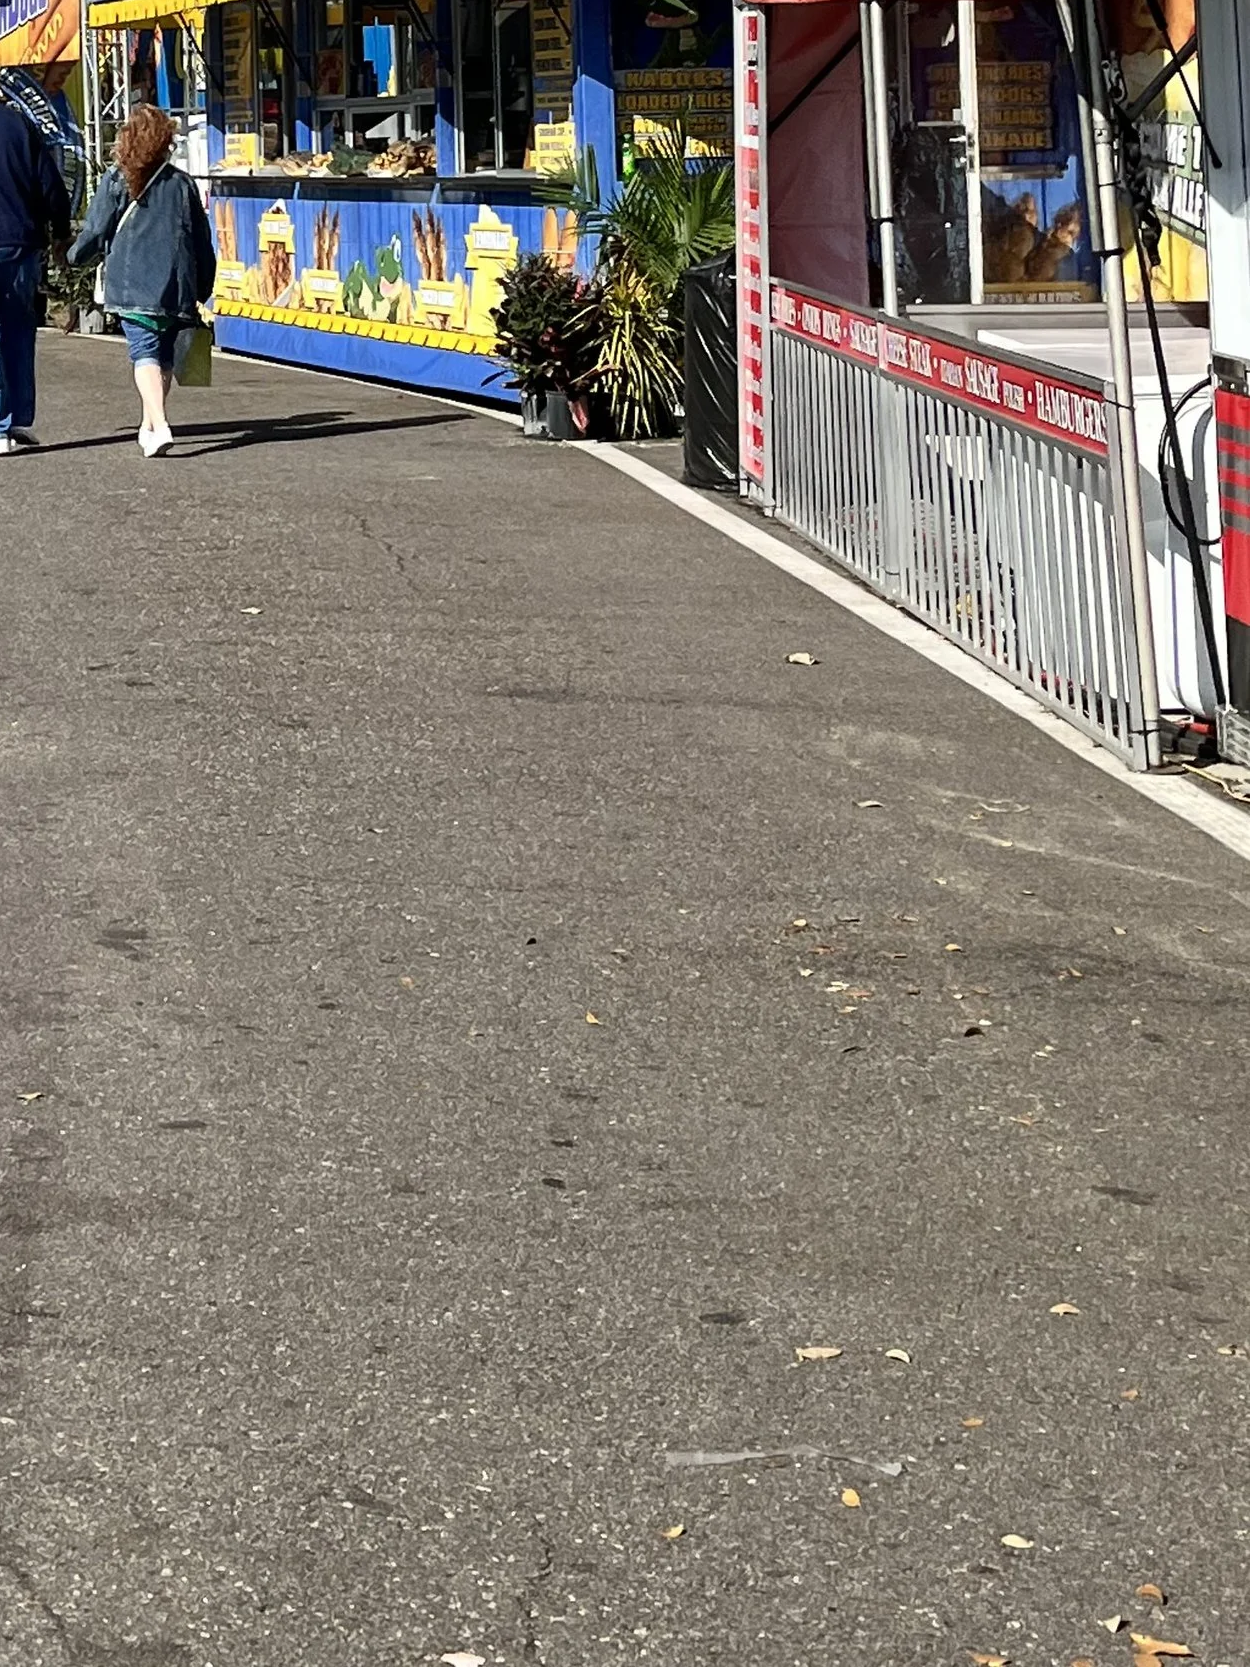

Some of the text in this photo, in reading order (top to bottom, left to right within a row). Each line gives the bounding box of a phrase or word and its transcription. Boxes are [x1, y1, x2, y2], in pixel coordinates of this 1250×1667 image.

[626, 70, 724, 88] KABOBS
[20, 86, 59, 134] CHIPS
[618, 93, 681, 111] LOADED
[1035, 380, 1109, 445] HAMBURGERS
